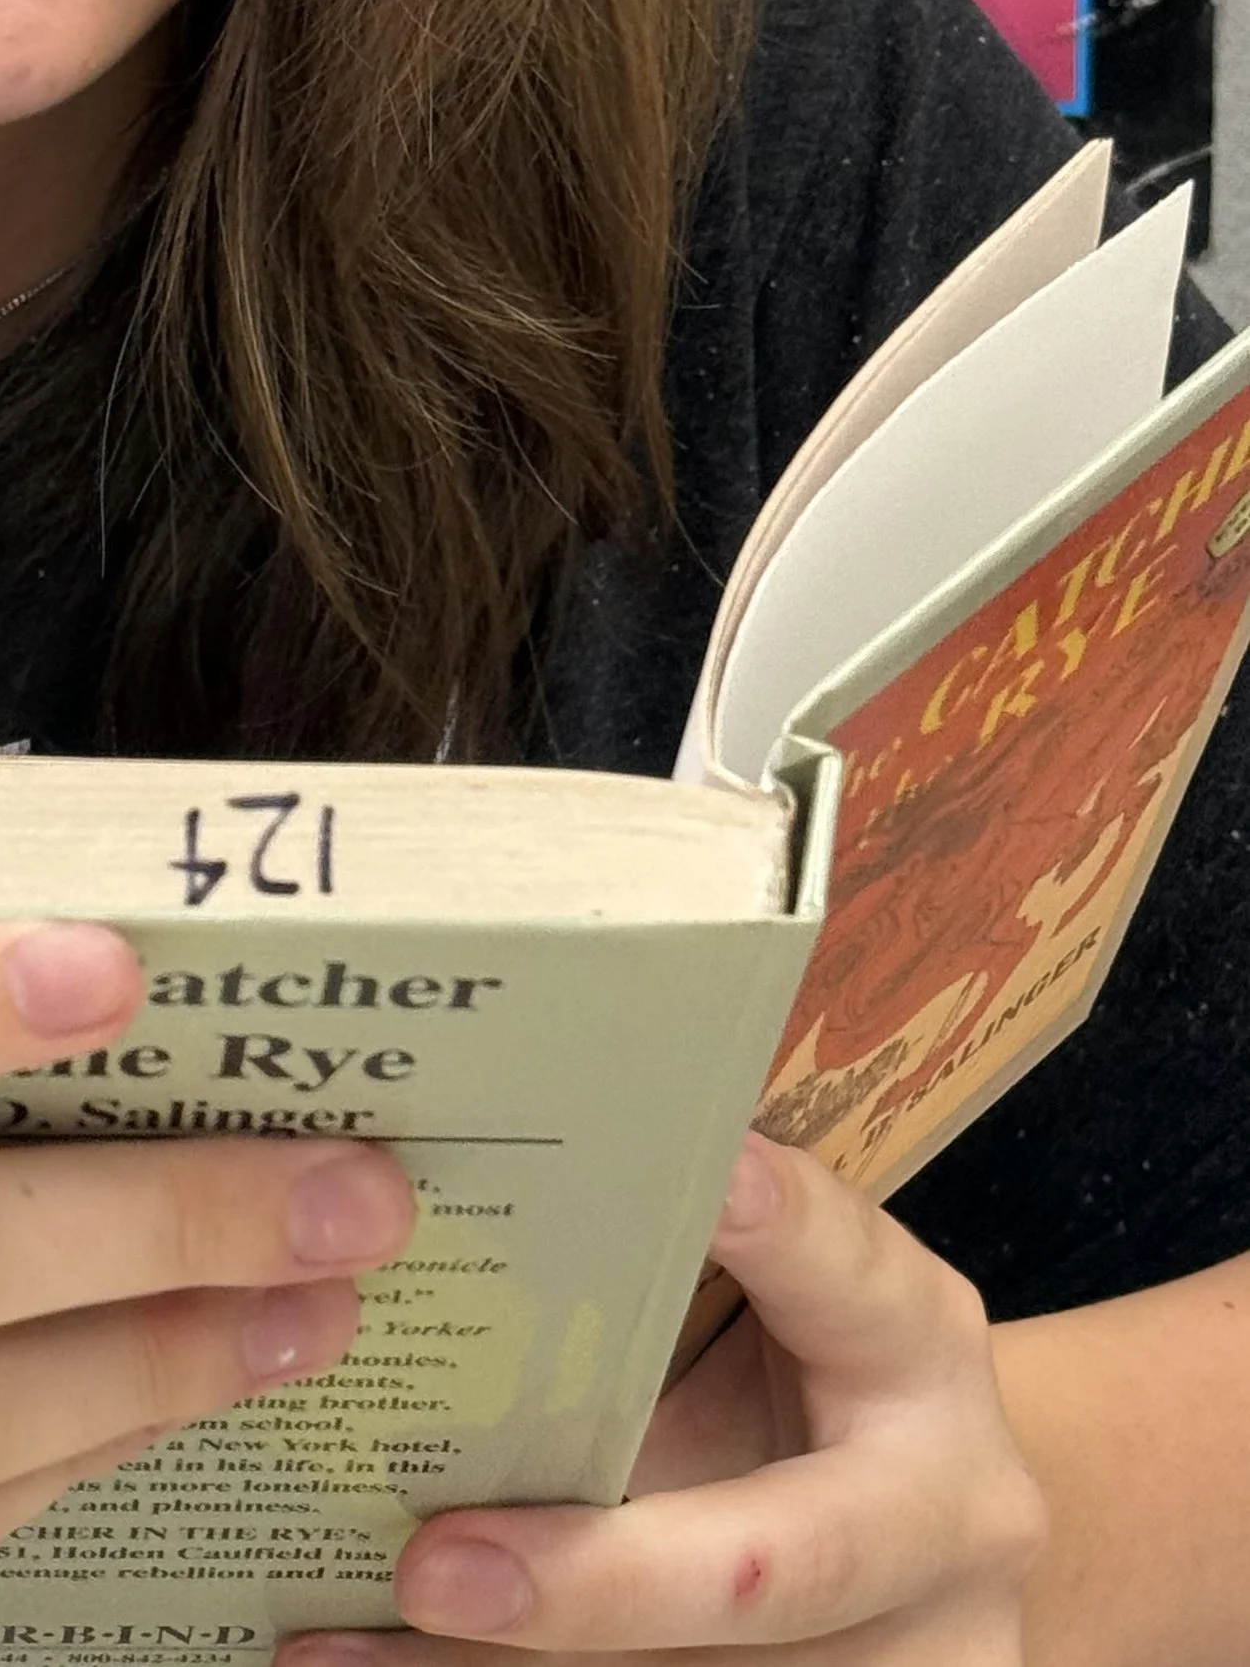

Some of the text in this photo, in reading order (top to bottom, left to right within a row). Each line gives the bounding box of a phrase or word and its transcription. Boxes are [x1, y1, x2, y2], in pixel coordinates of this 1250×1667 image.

[974, 544, 1178, 753] RYE
[169, 792, 337, 904] 124
[147, 960, 503, 1010] atcher
[906, 926, 1101, 1112] SALINGER
[212, 1034, 417, 1092] Rye
[77, 1097, 376, 1135] Salinger
[432, 1203, 515, 1216] most
[384, 1320, 492, 1336] Yorker
[283, 1374, 415, 1390] udents,
[319, 1395, 452, 1411] brother.
[240, 1416, 355, 1432] school,
[166, 1440, 185, 1451] a
[199, 1437, 268, 1452] New
[282, 1437, 358, 1453] York
[370, 1438, 463, 1455] hotel,
[175, 1458, 205, 1472] in
[217, 1458, 262, 1472] his
[273, 1459, 335, 1474] life,
[345, 1459, 375, 1473] in
[388, 1460, 446, 1474] this
[113, 1479, 137, 1492] is
[150, 1481, 232, 1493] more
[243, 1479, 409, 1495] loneliness,
[79, 1499, 140, 1512] and
[152, 1498, 322, 1514] phoniness.
[129, 1526, 168, 1541] IN
[179, 1526, 258, 1541] THE
[270, 1526, 372, 1543] RYE's
[52, 1546, 164, 1560] Holden
[177, 1546, 323, 1561] Caulfield
[334, 1548, 388, 1561] has
[118, 1566, 254, 1580] rebellion
[266, 1566, 326, 1580] and
[68, 1652, 232, 1665] 800-842-4234
